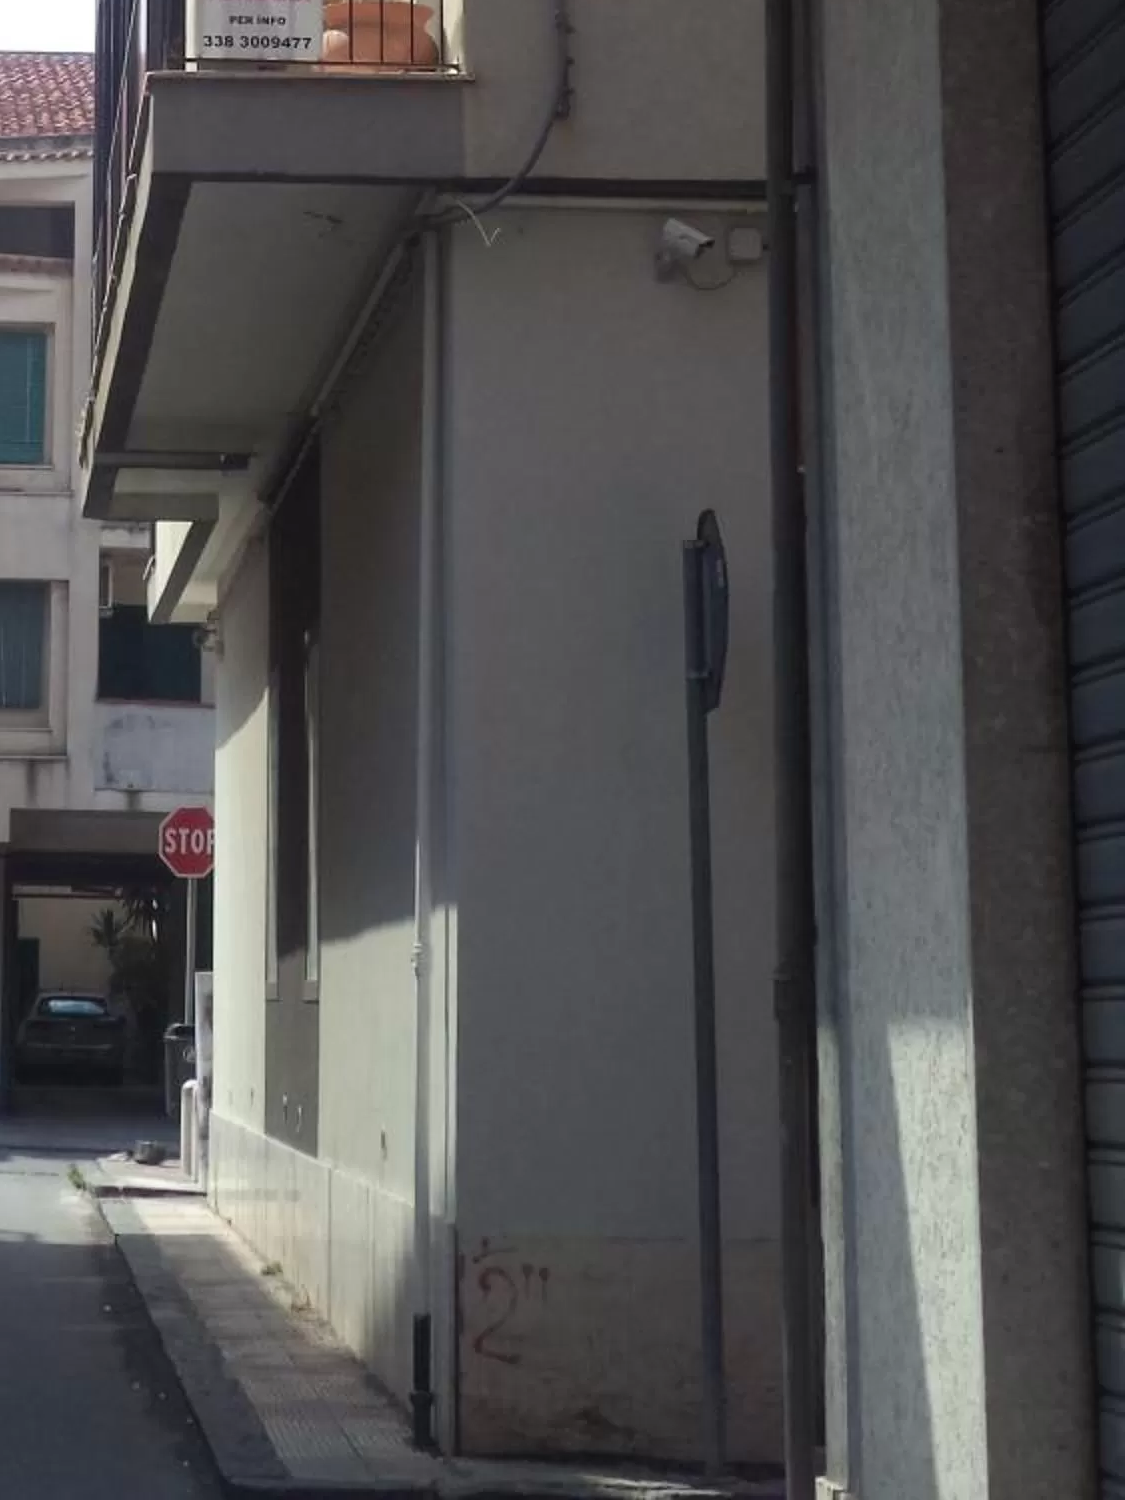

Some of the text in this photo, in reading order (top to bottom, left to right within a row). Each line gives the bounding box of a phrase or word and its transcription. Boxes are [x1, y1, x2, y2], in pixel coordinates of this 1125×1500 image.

[229, 15, 254, 25] PER
[203, 35, 312, 49] 338 3009477
